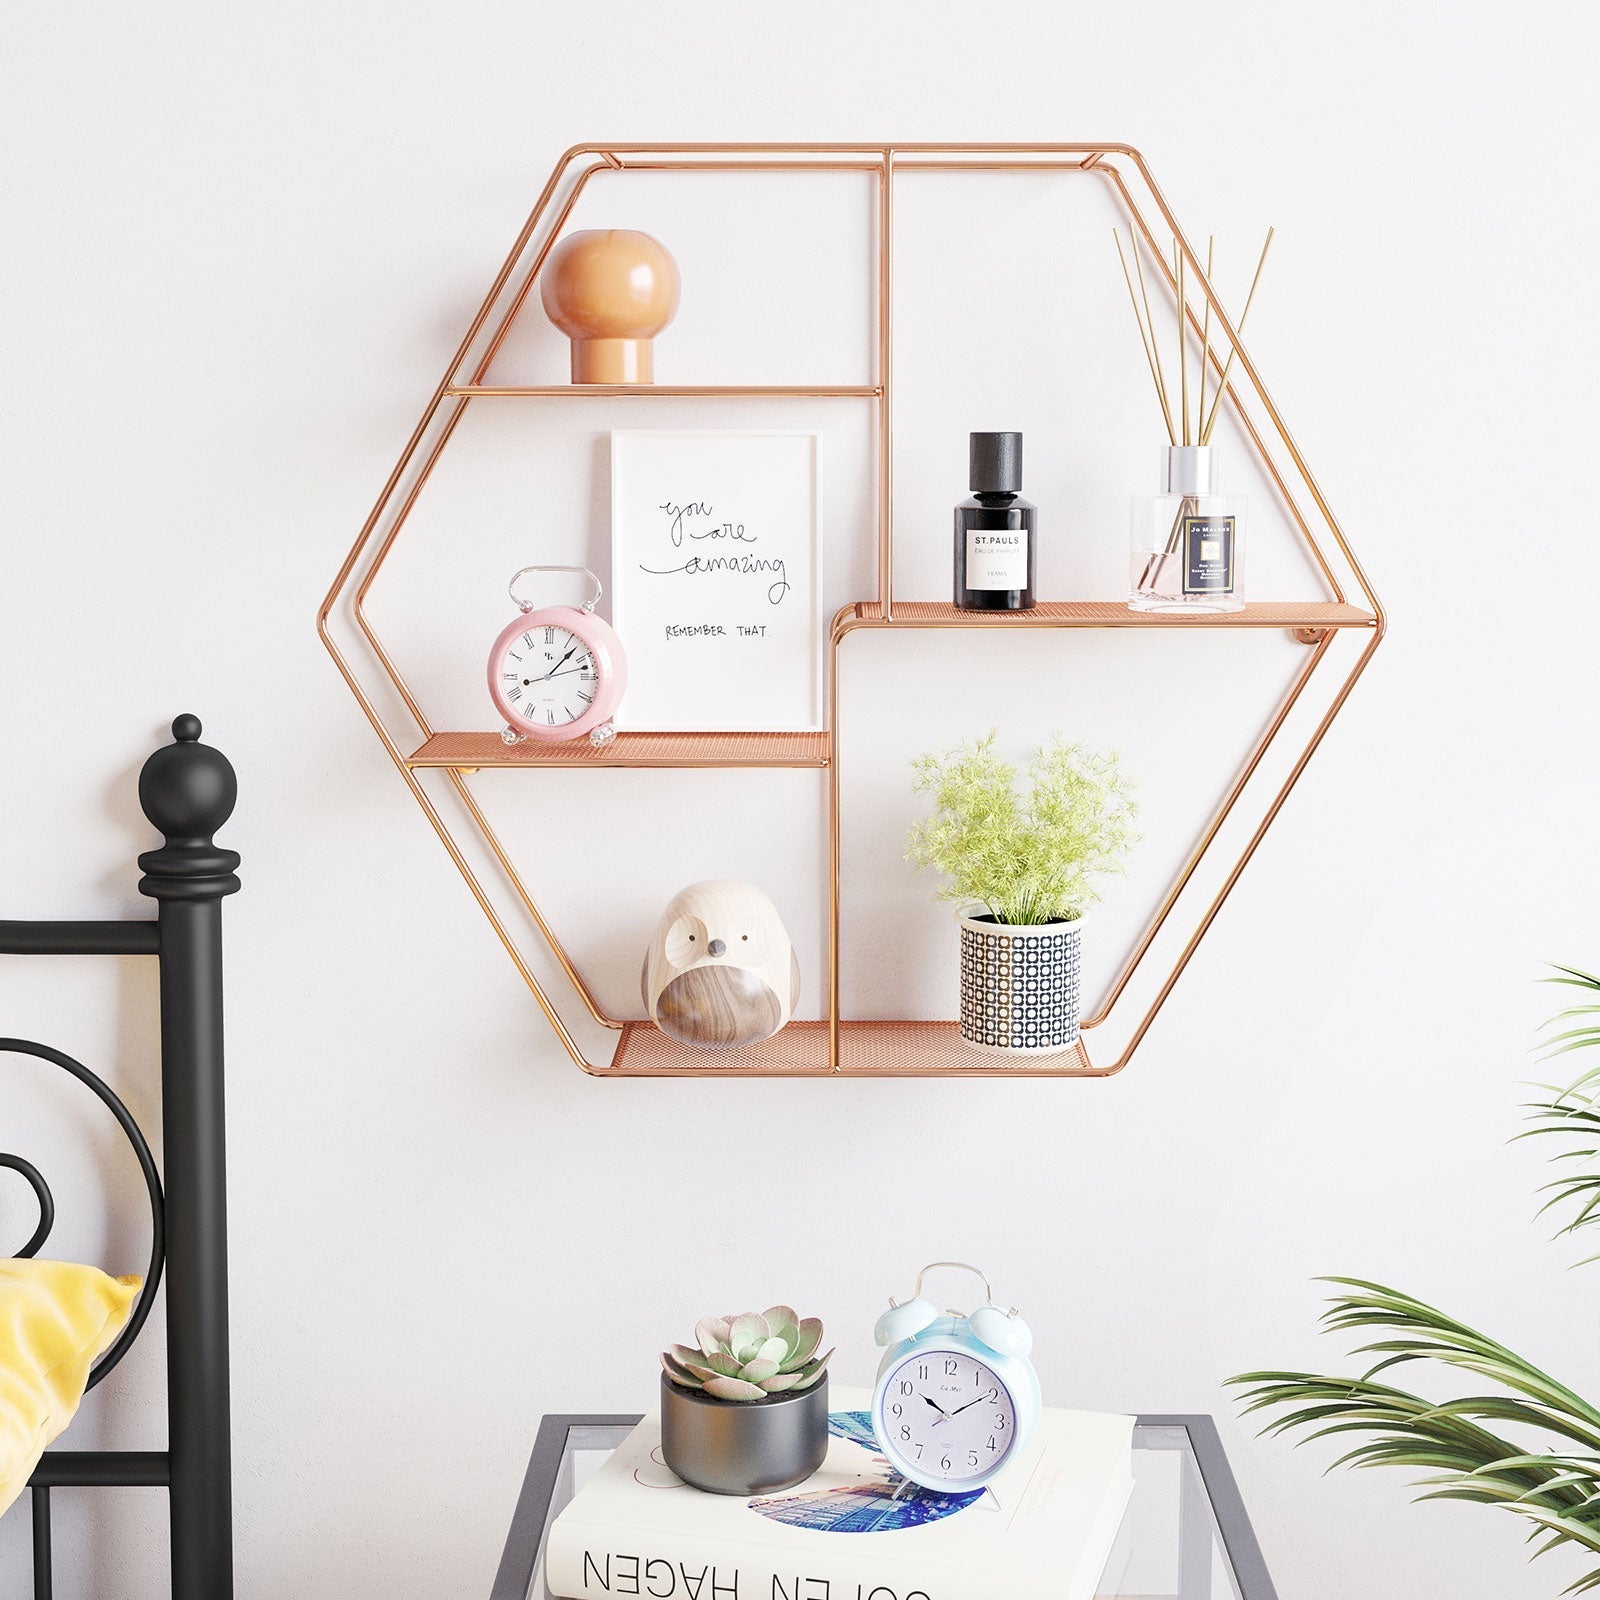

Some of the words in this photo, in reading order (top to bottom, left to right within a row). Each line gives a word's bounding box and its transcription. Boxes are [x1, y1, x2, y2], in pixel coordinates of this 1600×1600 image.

[659, 502, 713, 547] you
[690, 523, 758, 542] are
[975, 536, 1019, 544] ST.PAULS
[639, 554, 790, 605] amazing
[544, 628, 555, 644] XII
[665, 625, 727, 641] REMEMBER
[919, 1365, 928, 1380] 11
[945, 1360, 957, 1375] 12
[975, 1371, 979, 1386] 1
[900, 1381, 913, 1396] 10
[988, 1388, 998, 1404] 2
[892, 1404, 902, 1420] 9
[994, 1413, 1005, 1430] 3
[900, 1425, 910, 1440] 8
[915, 1443, 923, 1459] 7
[986, 1435, 996, 1451] 4
[941, 1454, 951, 1470] 6
[967, 1450, 978, 1466] 5
